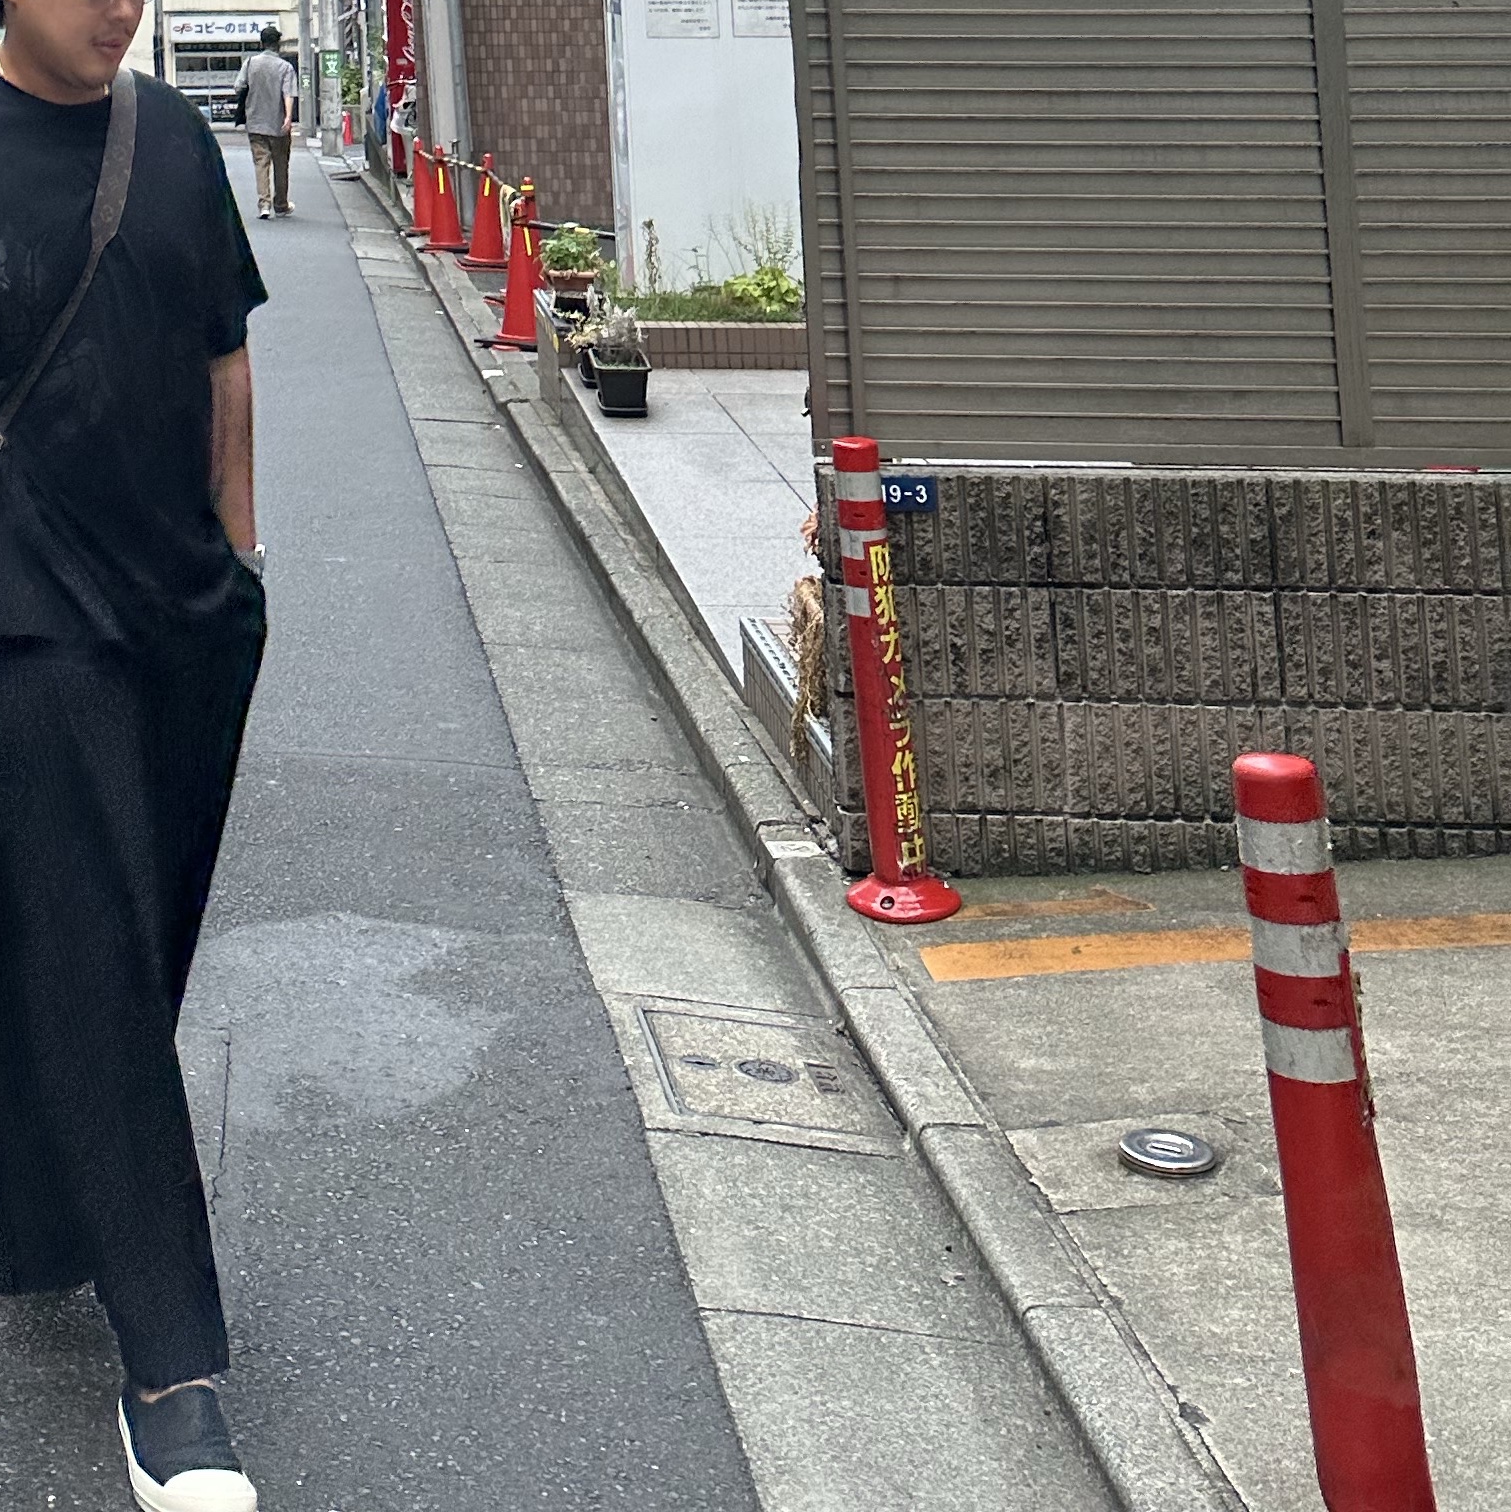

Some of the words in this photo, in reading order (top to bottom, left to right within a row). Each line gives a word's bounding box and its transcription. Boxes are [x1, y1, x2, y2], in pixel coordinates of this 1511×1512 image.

[194, 22, 236, 35] コピーの
[881, 484, 928, 503] 19-3
